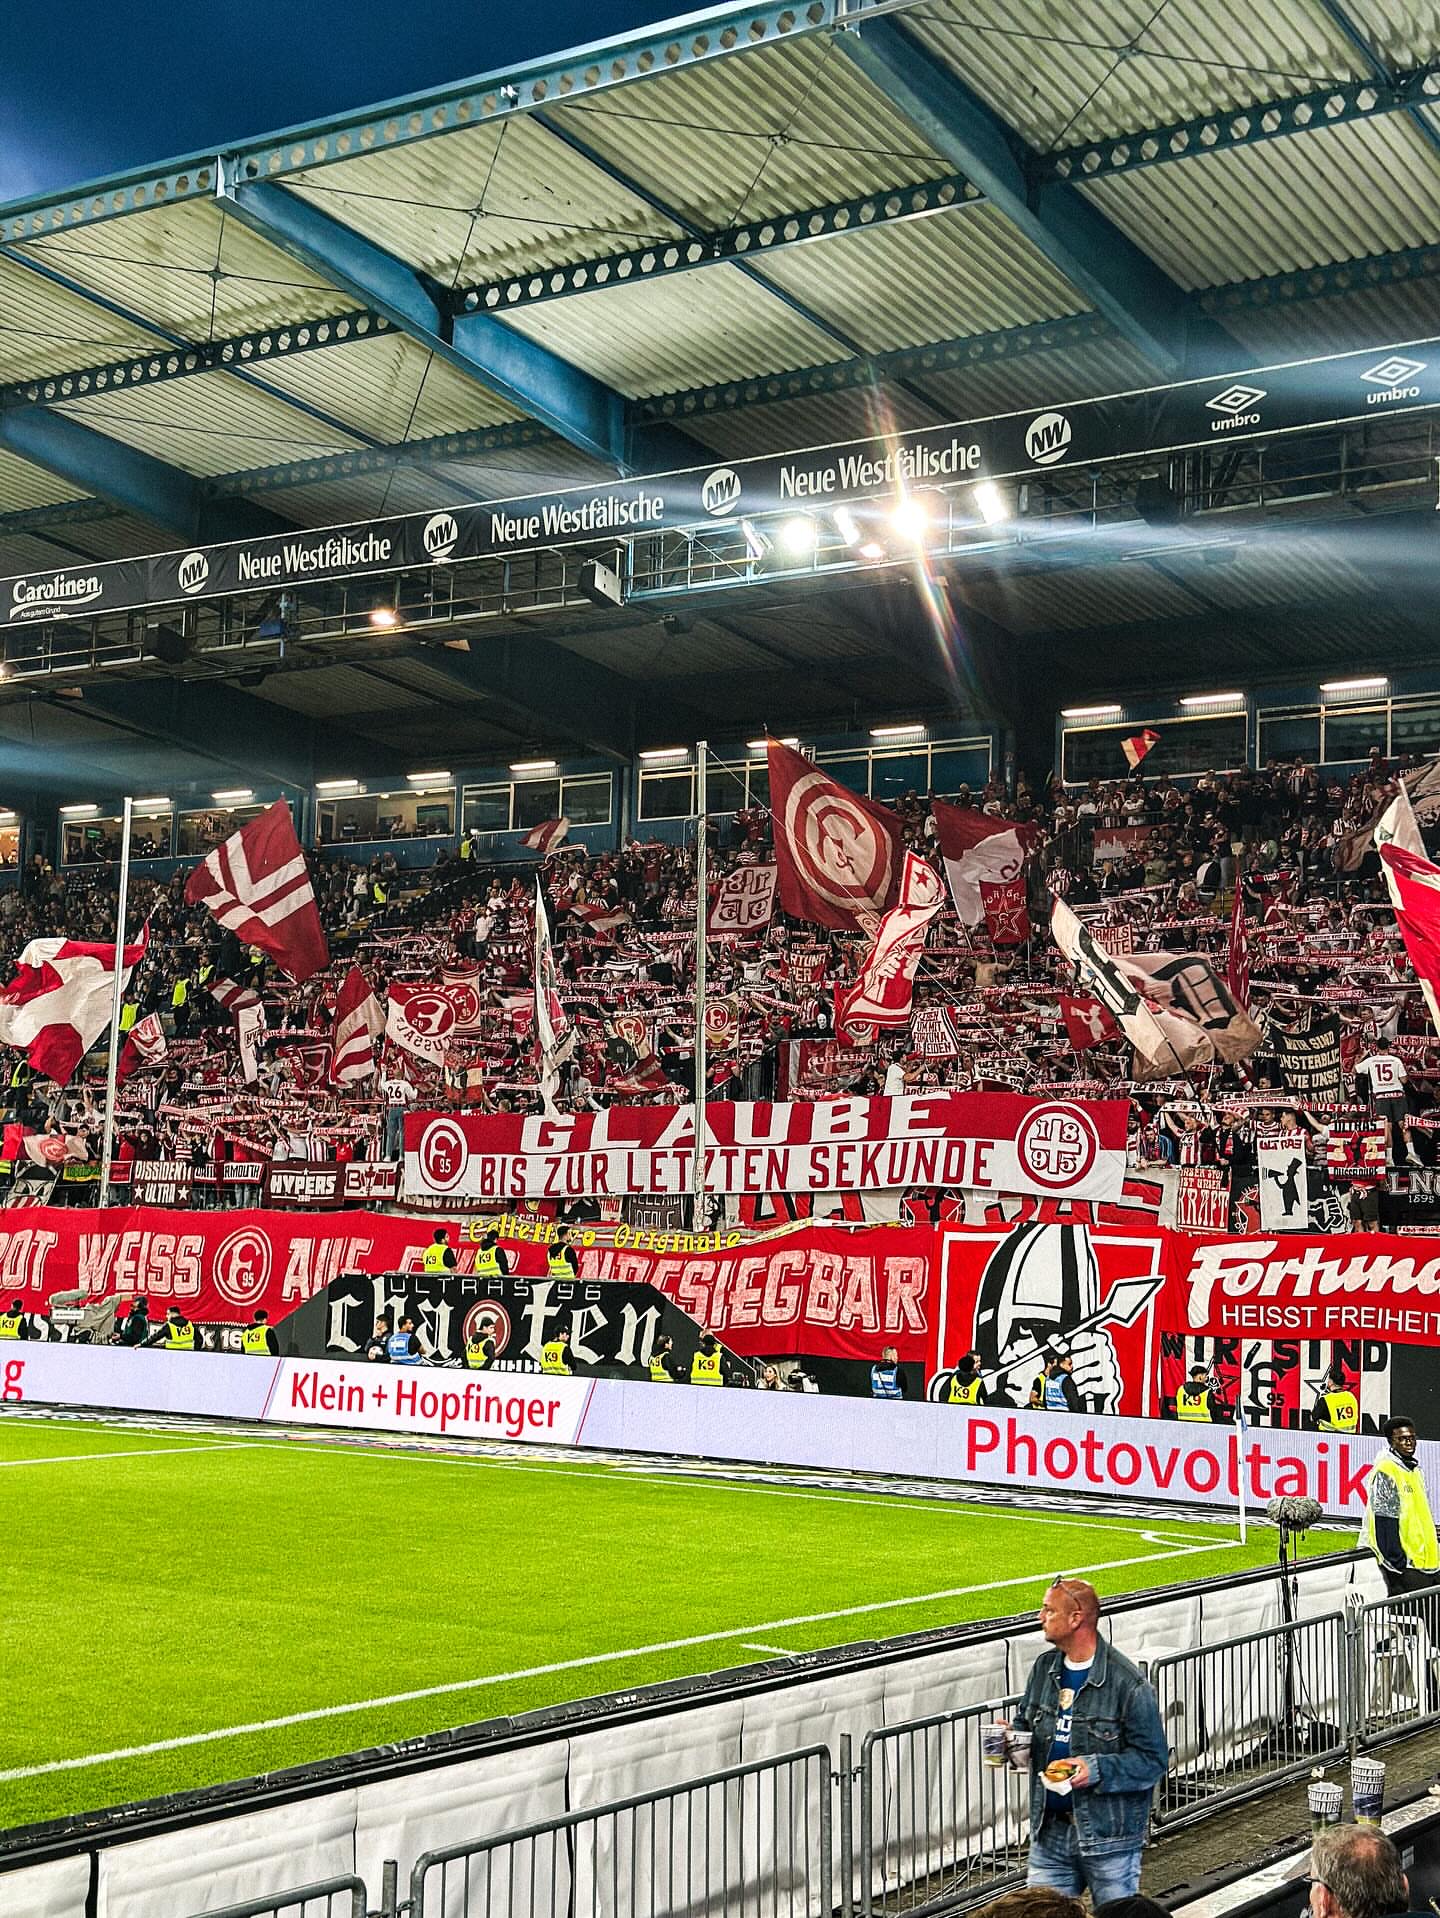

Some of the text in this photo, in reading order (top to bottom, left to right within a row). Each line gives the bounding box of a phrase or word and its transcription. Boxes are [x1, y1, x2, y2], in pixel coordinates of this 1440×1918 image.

[1367, 385, 1420, 404] umbro
[1211, 412, 1260, 431] umbro
[1031, 420, 1065, 454] NW
[780, 439, 981, 498] Neue Westfälische
[705, 478, 738, 506] NW
[491, 492, 664, 544] Neue Westfälische
[427, 522, 456, 548] NW
[239, 534, 391, 581] Neue Westfälische
[181, 555, 207, 584] NW
[13, 575, 98, 603] Carolinen
[1375, 1064, 1393, 1081] 15
[387, 1085, 401, 1099] 26
[1317, 1103, 1367, 1112] ULTRAS
[519, 1092, 952, 1155] GLAUBE
[480, 1140, 995, 1196] BIS ZUR LETZTEN SEKUNDE
[270, 1175, 336, 1194] HYPERS
[78, 1231, 206, 1297] WEISS
[425, 1255, 437, 1265] K9
[479, 1253, 492, 1264] K9
[391, 1277, 530, 1297] ULTRAS
[2, 1318, 15, 1329] K9
[1222, 1305, 1317, 1328] HEISST
[247, 1332, 260, 1344] K9
[467, 1343, 480, 1354] K9
[544, 1351, 559, 1362] K9
[1161, 1332, 1390, 1373] WIR SIND
[698, 1359, 715, 1371] K9
[953, 1386, 970, 1399] K9
[1182, 1392, 1201, 1407] K9
[291, 1373, 368, 1413] Klein
[396, 1378, 560, 1438] Hopfinger
[1336, 1405, 1354, 1421] K9
[967, 1418, 1374, 1507] Photovoltaik
